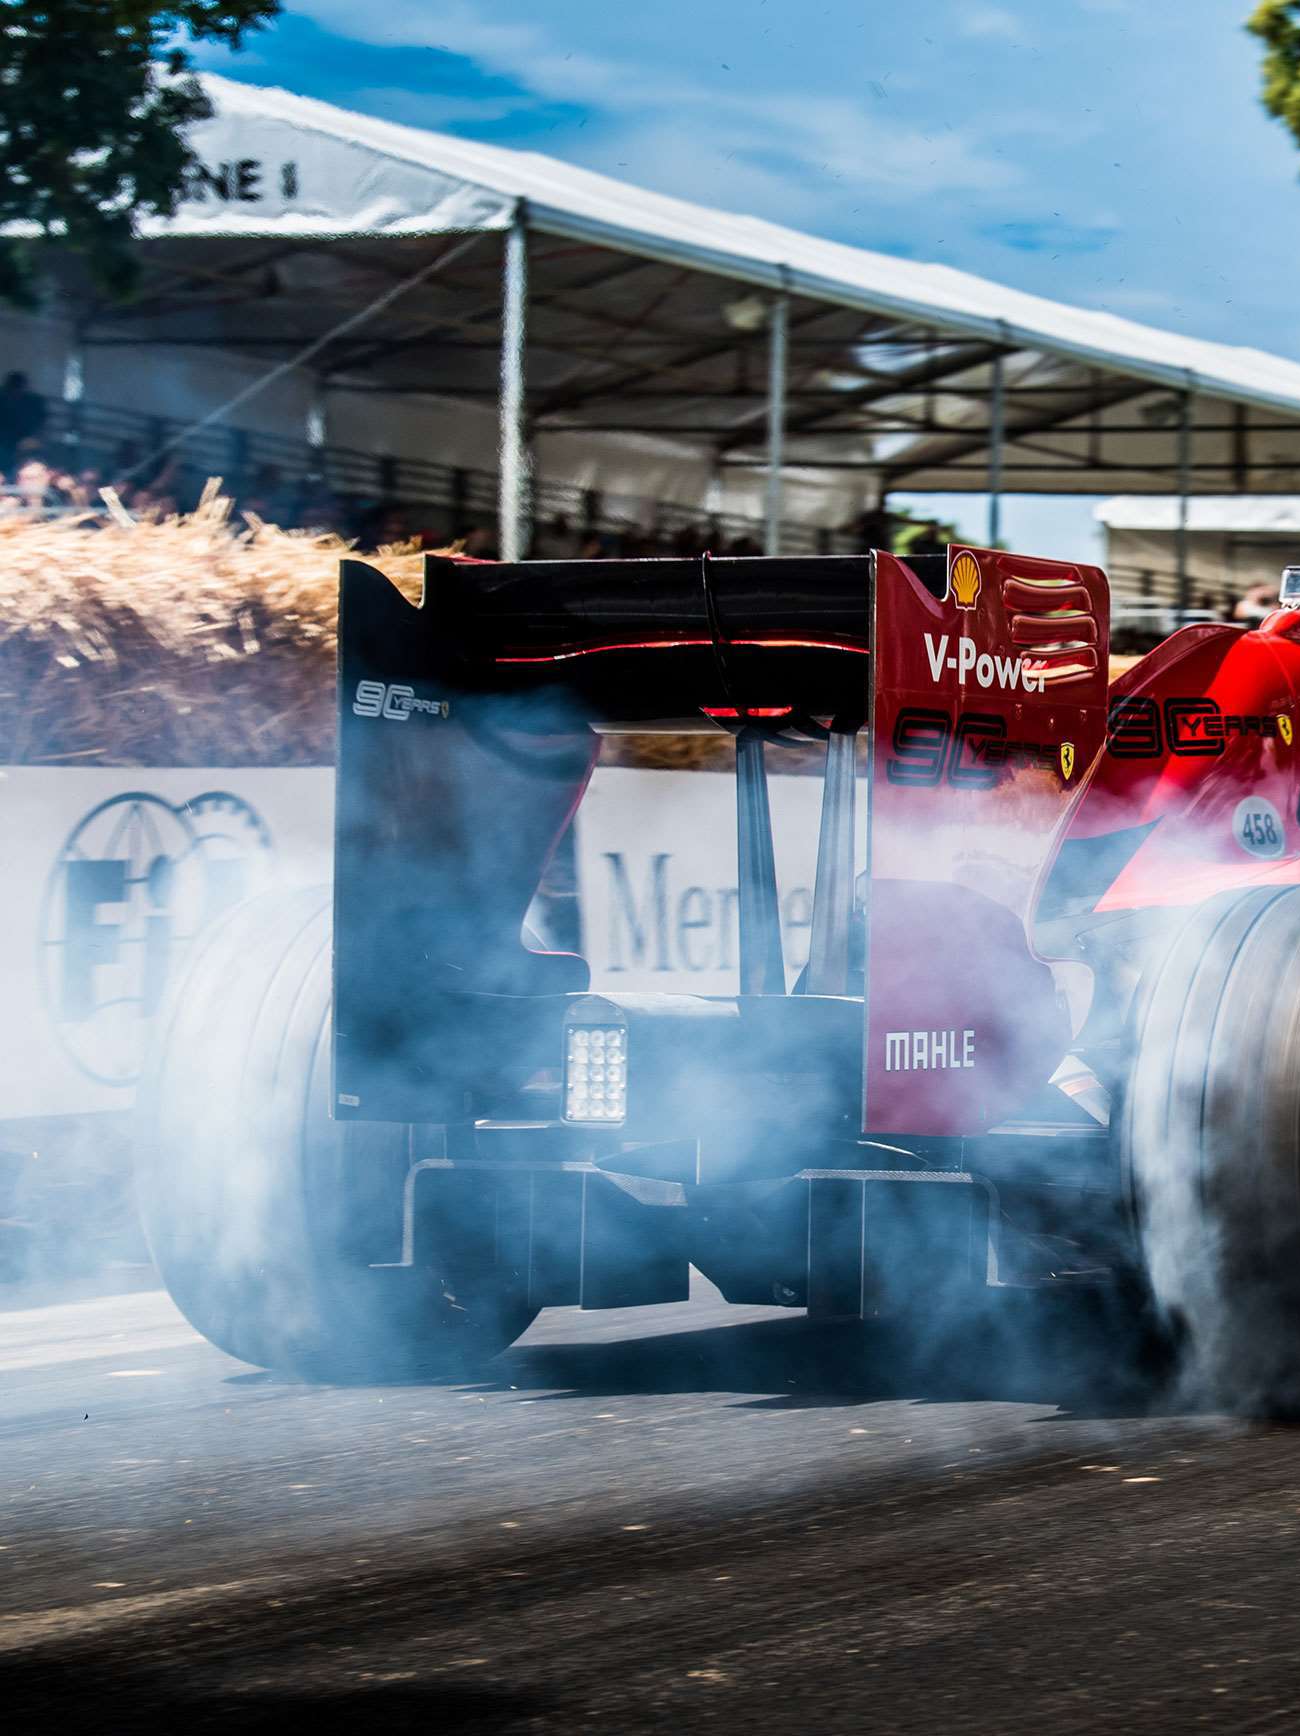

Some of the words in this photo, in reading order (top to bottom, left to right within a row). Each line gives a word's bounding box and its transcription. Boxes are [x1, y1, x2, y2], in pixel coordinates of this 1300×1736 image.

[923, 632, 1048, 693] V-Power
[1243, 813, 1278, 845] 458
[601, 852, 814, 972] Mere
[886, 1030, 975, 1071] MAHLE
